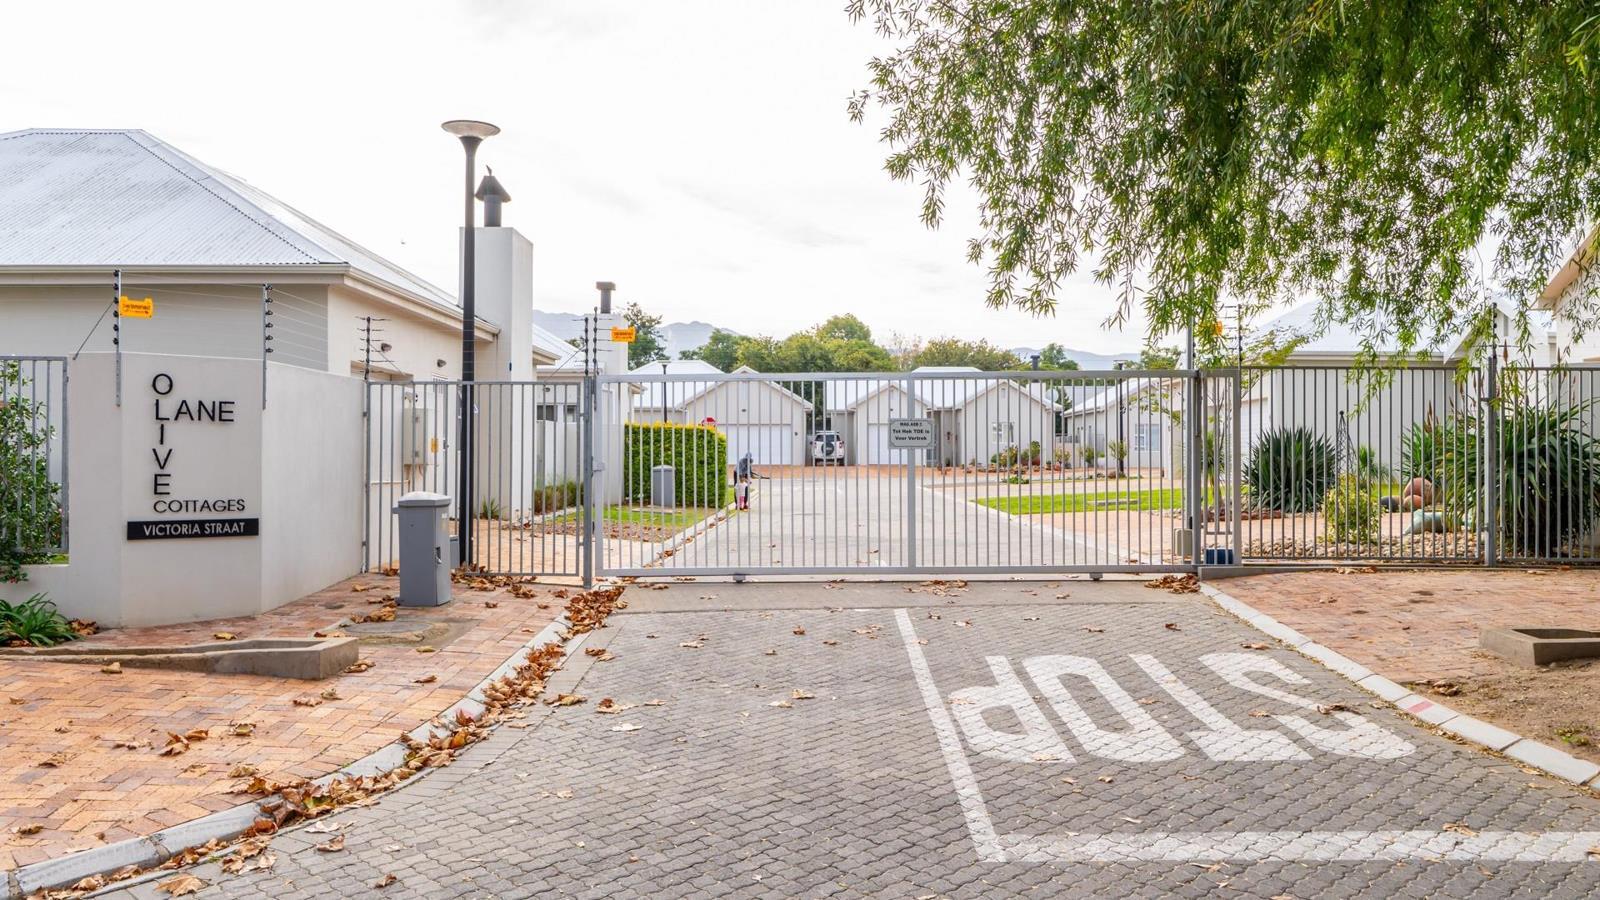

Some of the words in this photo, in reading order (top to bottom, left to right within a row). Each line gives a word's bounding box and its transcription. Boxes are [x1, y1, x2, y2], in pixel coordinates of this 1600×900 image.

[155, 399, 235, 422] LANE
[152, 373, 174, 496] OLIVE
[153, 499, 246, 513] COTTAGES
[143, 524, 201, 536] VICTORIA
[204, 522, 245, 534] STRAAT
[948, 653, 1417, 763] STOP
